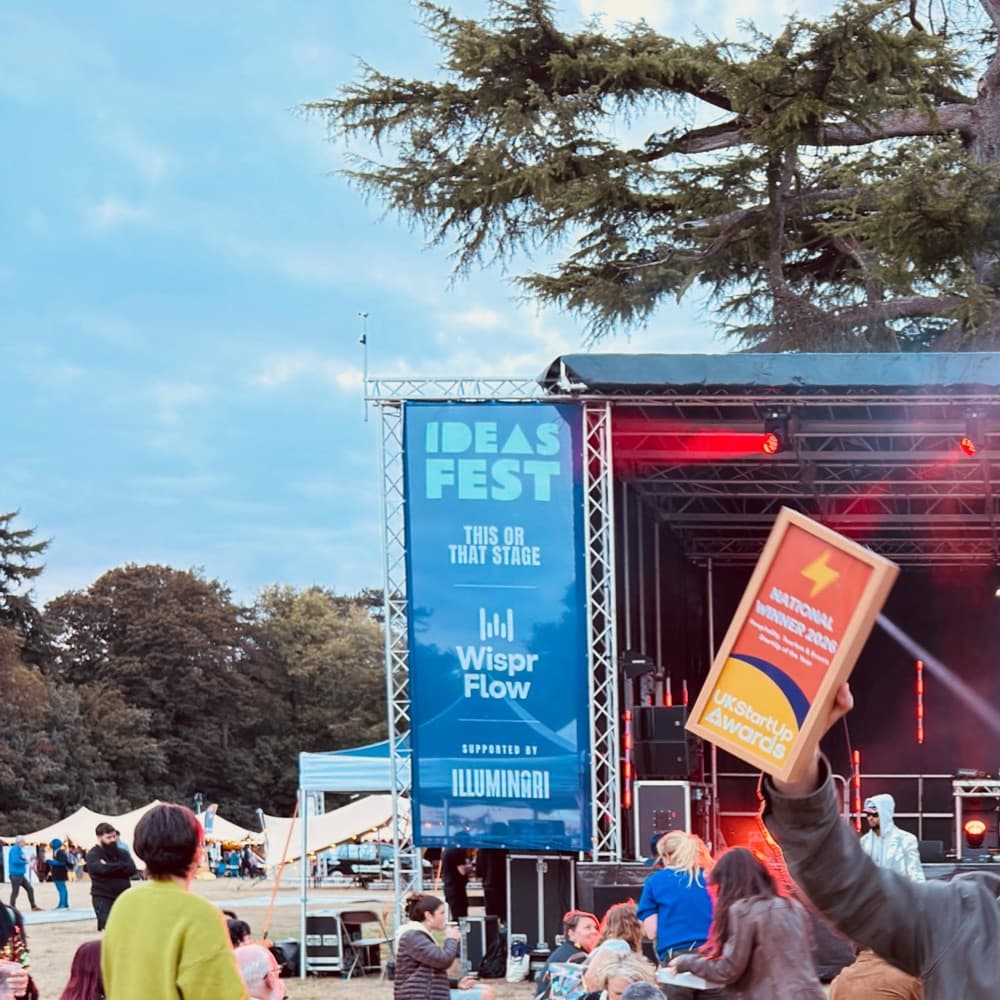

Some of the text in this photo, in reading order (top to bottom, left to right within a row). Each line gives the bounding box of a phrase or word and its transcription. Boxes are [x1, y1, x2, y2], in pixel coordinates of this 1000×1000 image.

[425, 421, 561, 456] IDEAS
[425, 458, 561, 502] FEST
[464, 525, 524, 546] THIS OR
[448, 544, 541, 566] THAT STAGE
[756, 600, 806, 636] WINNER
[770, 587, 833, 632] NATIONAL
[456, 645, 539, 676] Wispr
[464, 673, 531, 700] Flow
[462, 744, 538, 755] SUPPORTED BY
[707, 708, 786, 760] Awards
[452, 769, 550, 799] ILLUMINARI
